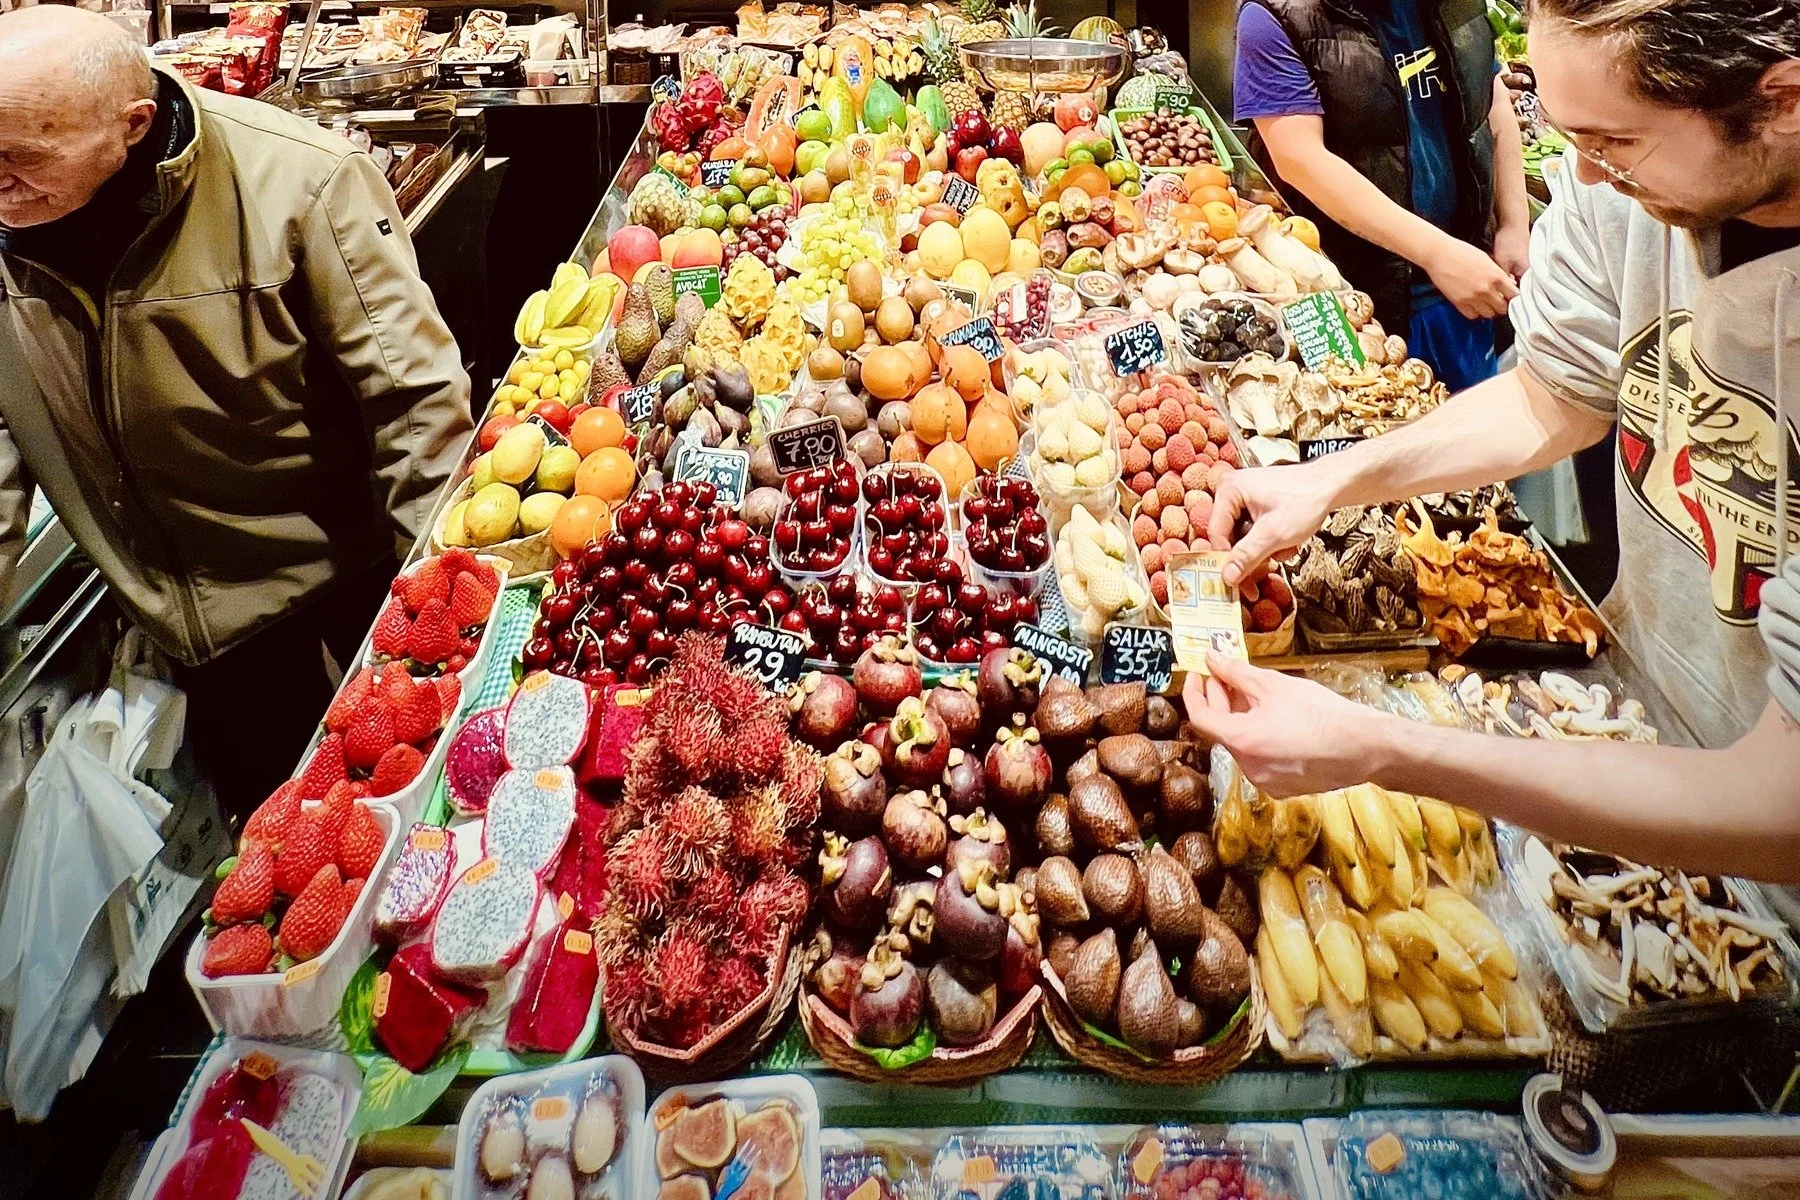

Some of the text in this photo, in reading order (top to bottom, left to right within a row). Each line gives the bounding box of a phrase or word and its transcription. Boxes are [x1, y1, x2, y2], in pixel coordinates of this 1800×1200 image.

[676, 278, 708, 293] AVOCAT
[1107, 321, 1157, 350] LITCHIS
[623, 381, 662, 403] FIGUES
[629, 395, 654, 422] 18
[777, 421, 834, 442] CHERRIES
[784, 434, 836, 463] 7.90
[1713, 500, 1751, 528] THE
[1109, 628, 1167, 652] SALAK
[744, 647, 785, 683] 29
